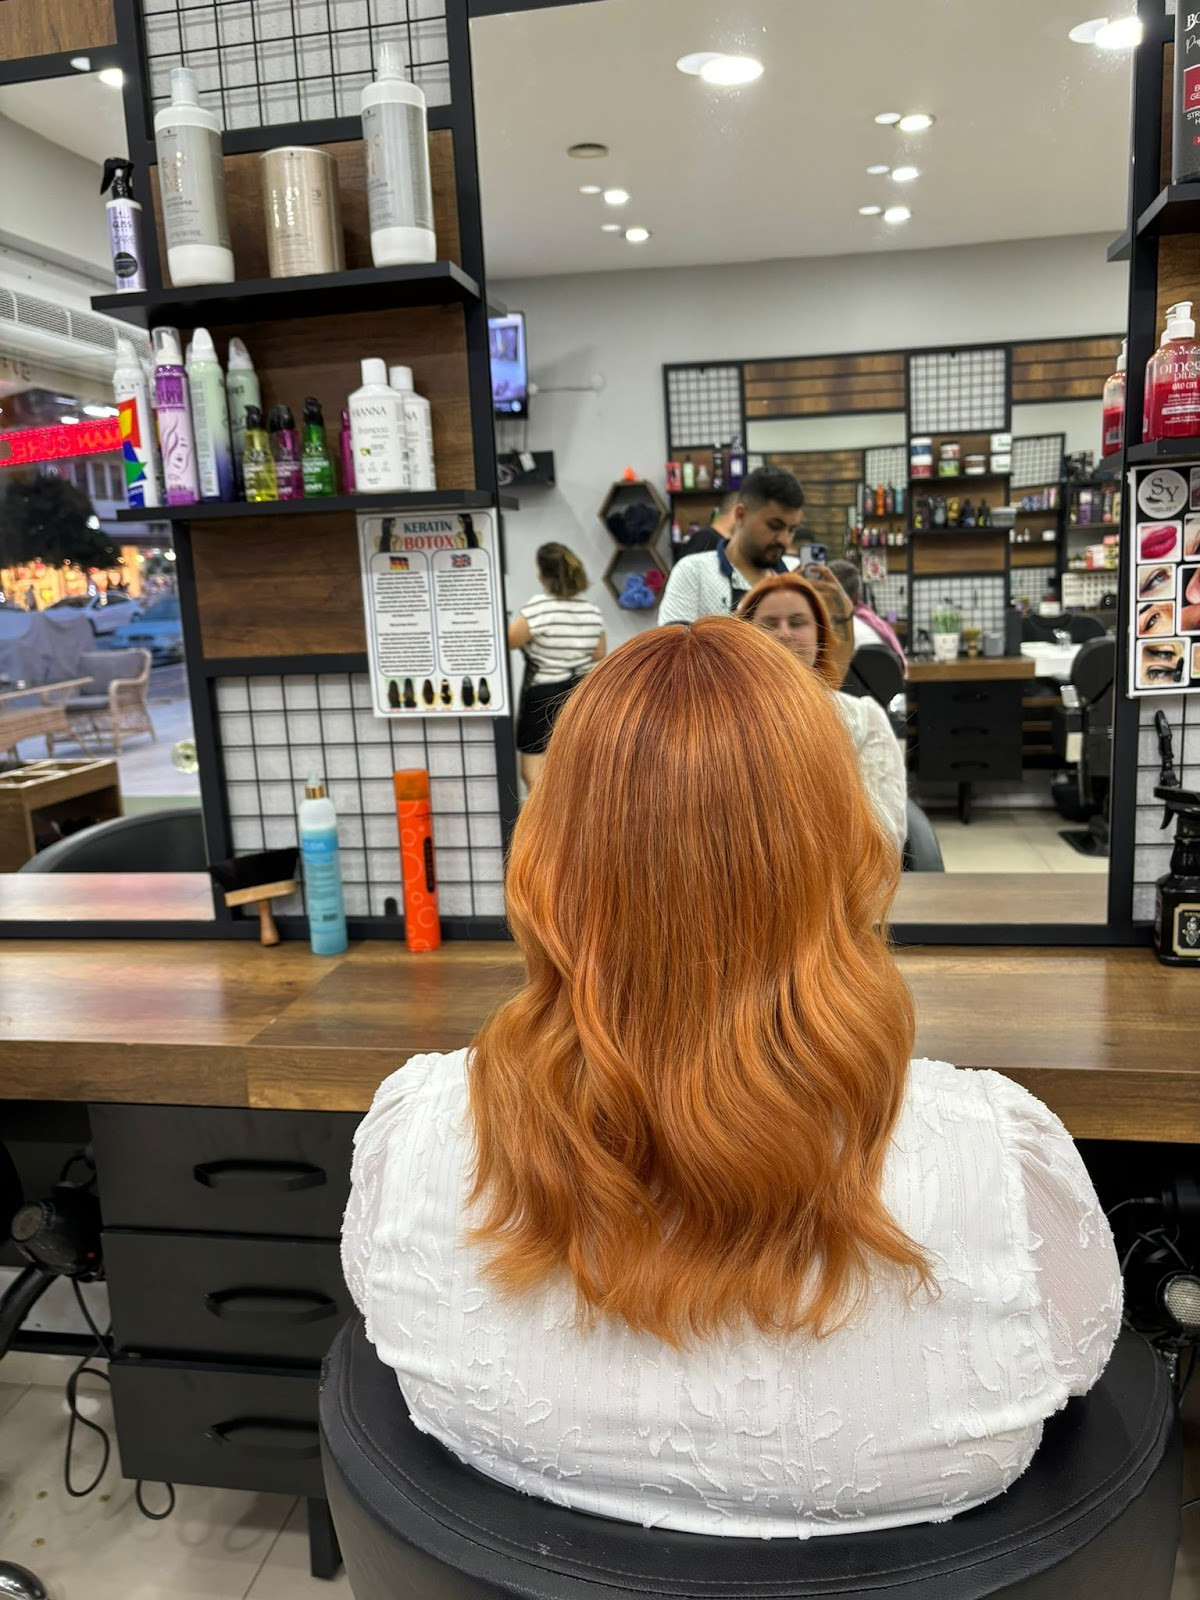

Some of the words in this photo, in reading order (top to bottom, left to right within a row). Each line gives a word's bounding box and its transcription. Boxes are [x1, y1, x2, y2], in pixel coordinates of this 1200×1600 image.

[1173, 370, 1197, 382] plus
[403, 521, 453, 533] KERATIN
[403, 534, 455, 550] BOTOX
